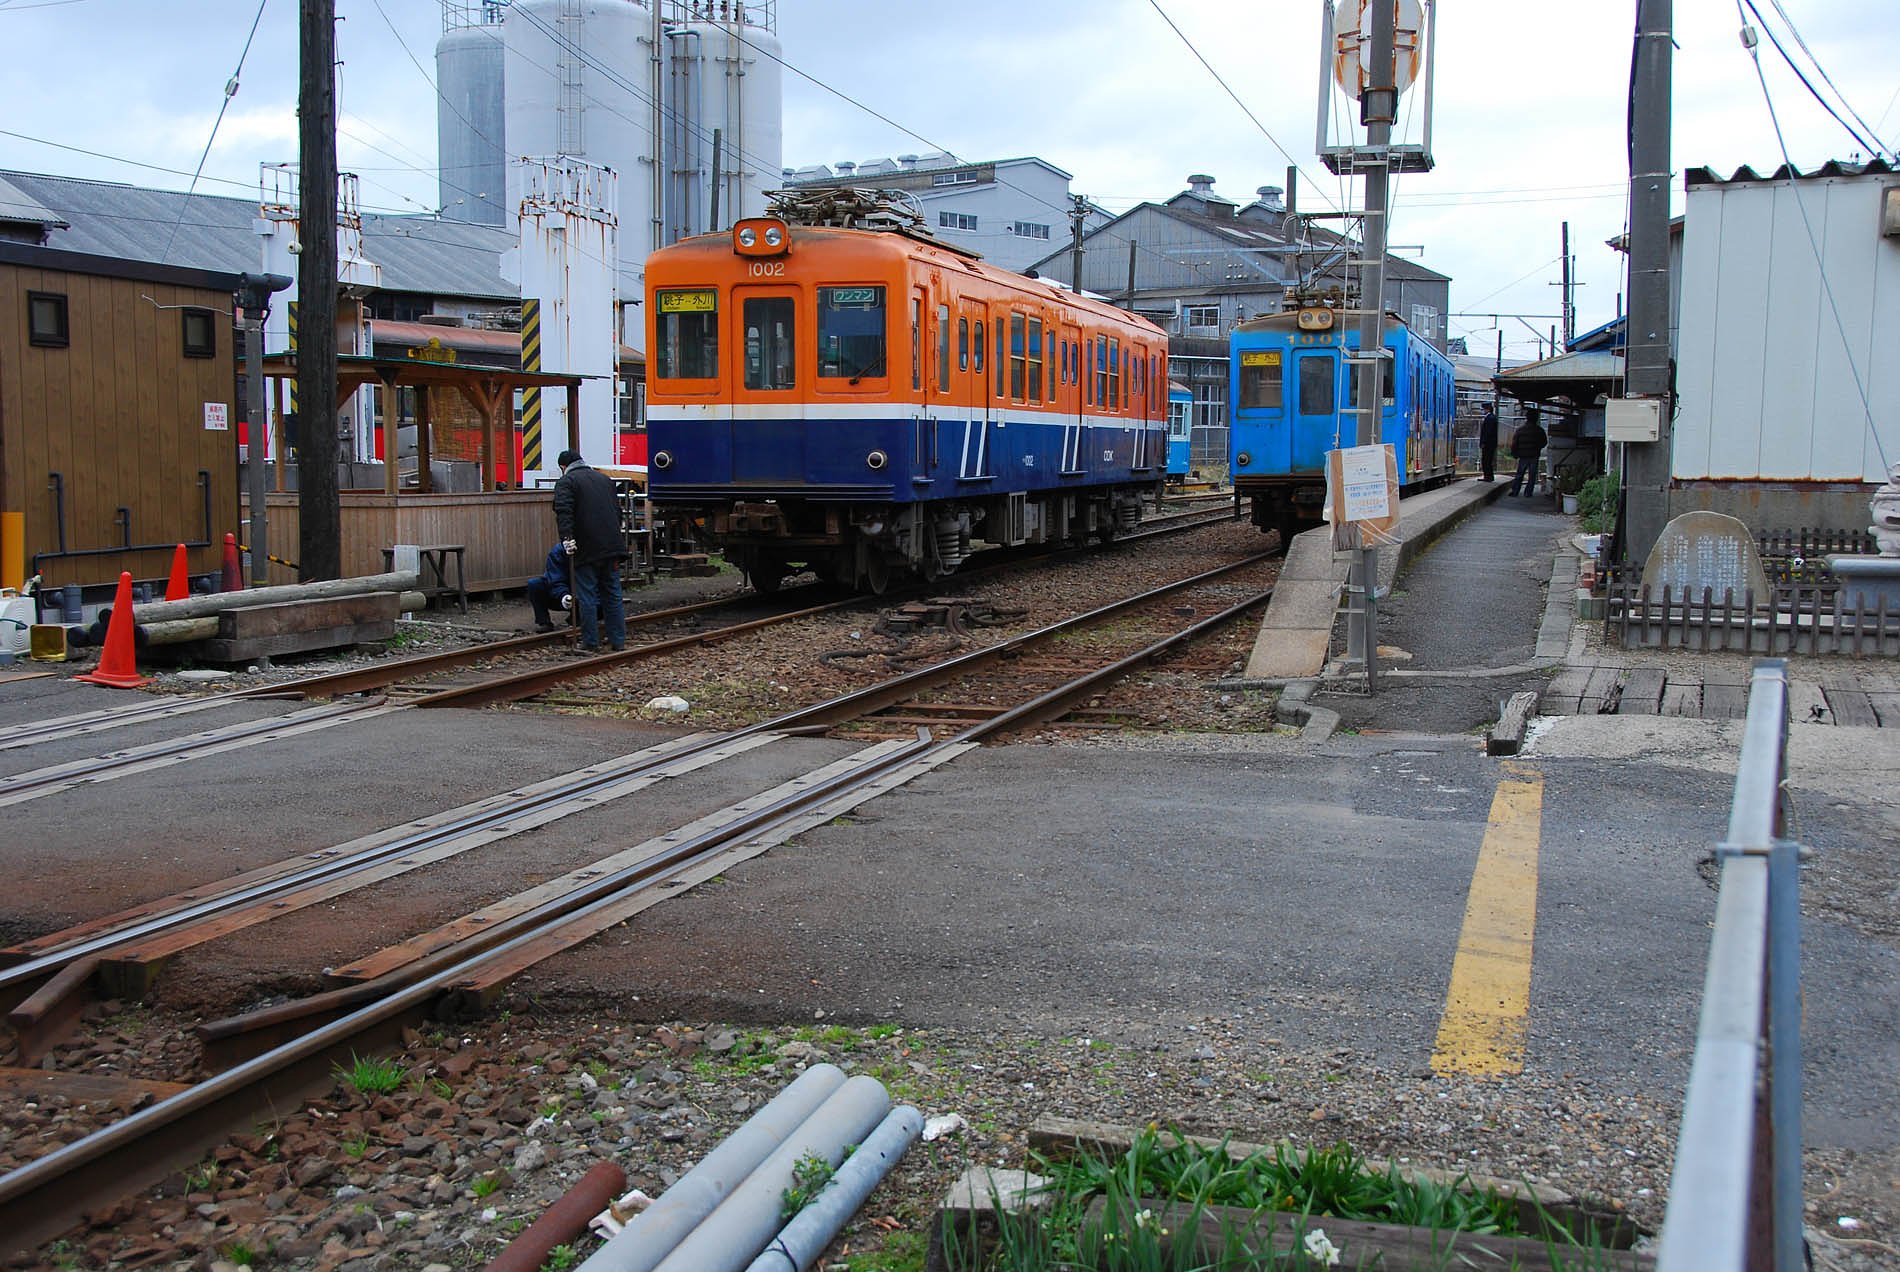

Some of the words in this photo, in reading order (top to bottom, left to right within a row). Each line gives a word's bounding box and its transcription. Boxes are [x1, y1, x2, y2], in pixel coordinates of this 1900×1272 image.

[748, 262, 785, 277] 1002
[835, 290, 872, 300] ワンマン
